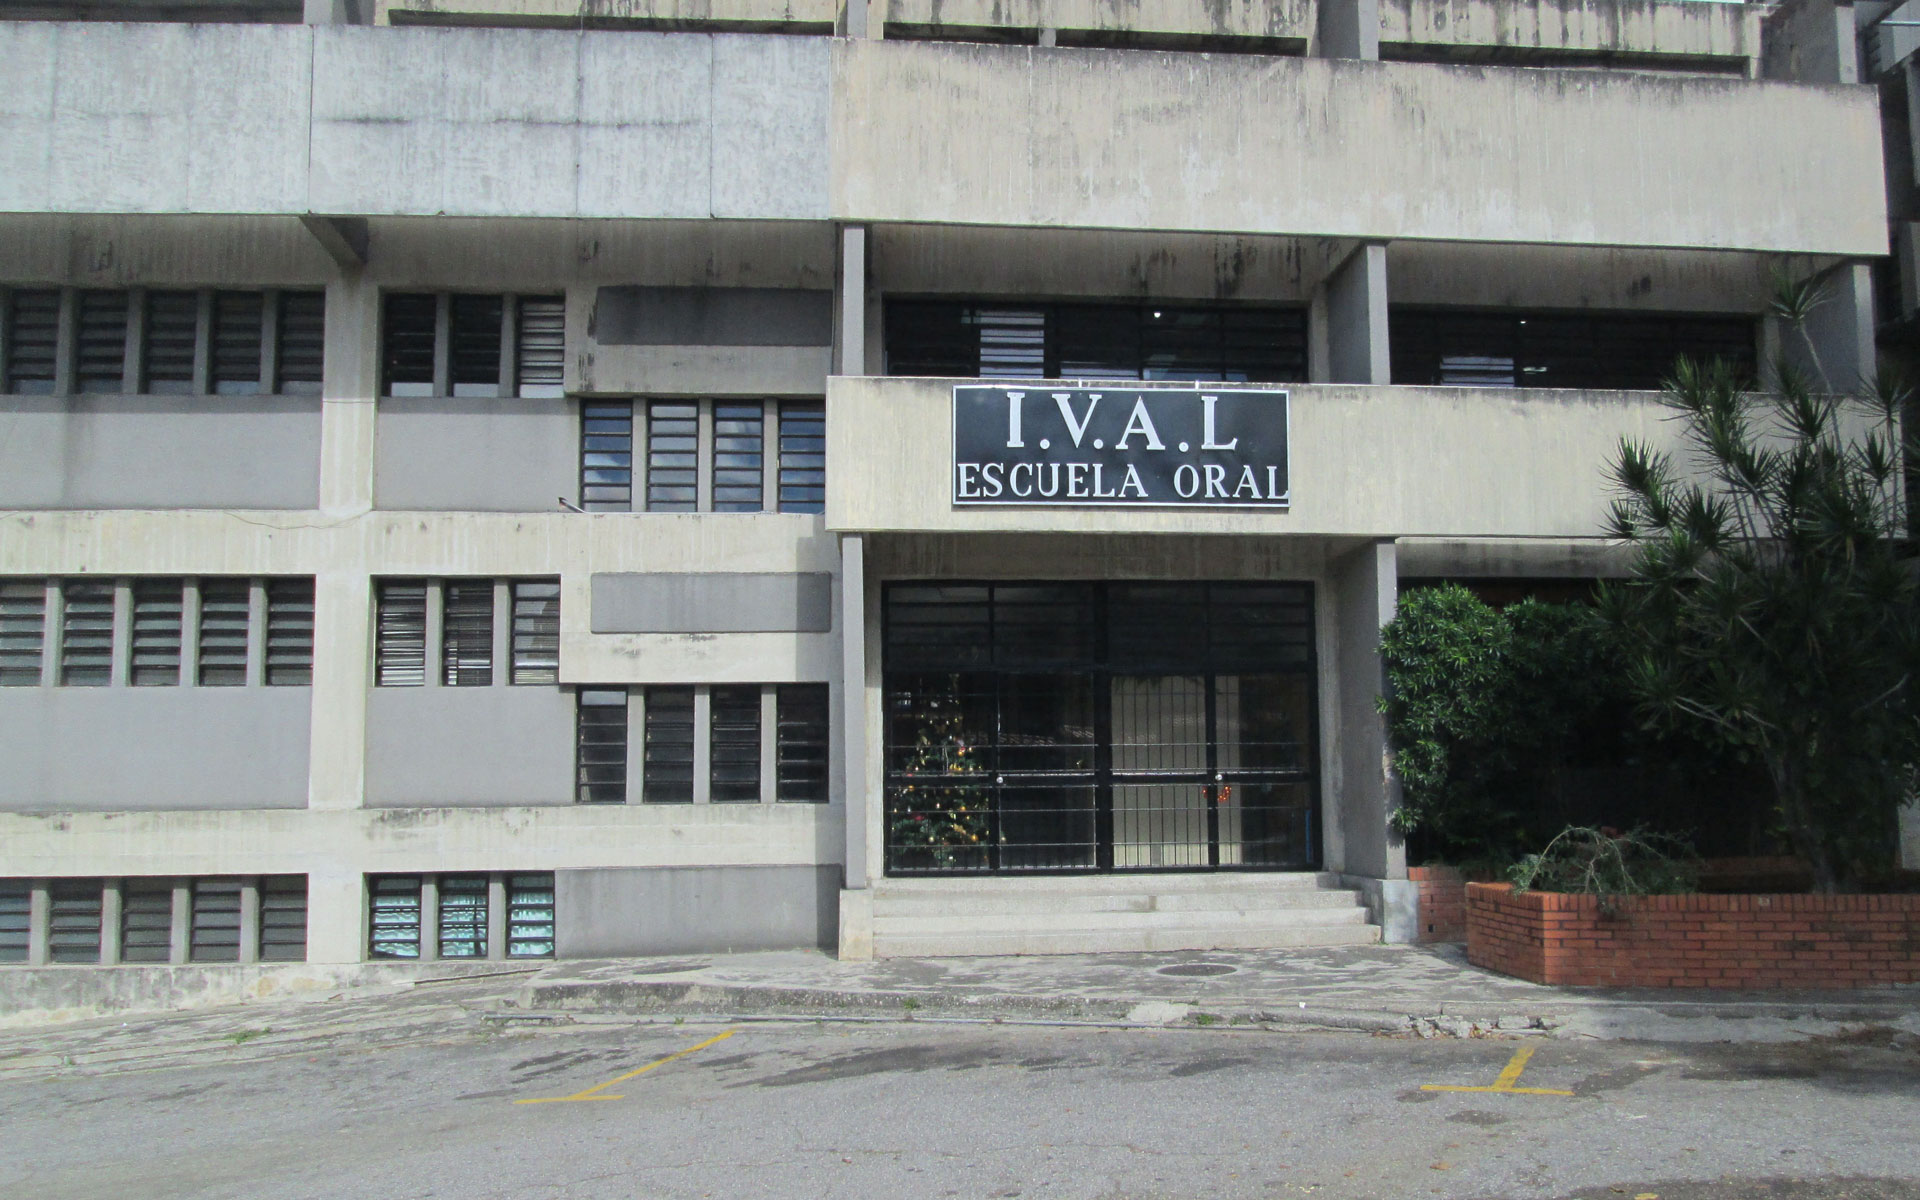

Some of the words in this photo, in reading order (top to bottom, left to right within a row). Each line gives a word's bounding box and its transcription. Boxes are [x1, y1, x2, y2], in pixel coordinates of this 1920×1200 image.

[1007, 392, 1238, 452] I.V.A.L
[957, 463, 1149, 498] ESCUELA
[1173, 464, 1288, 499] ORAL
